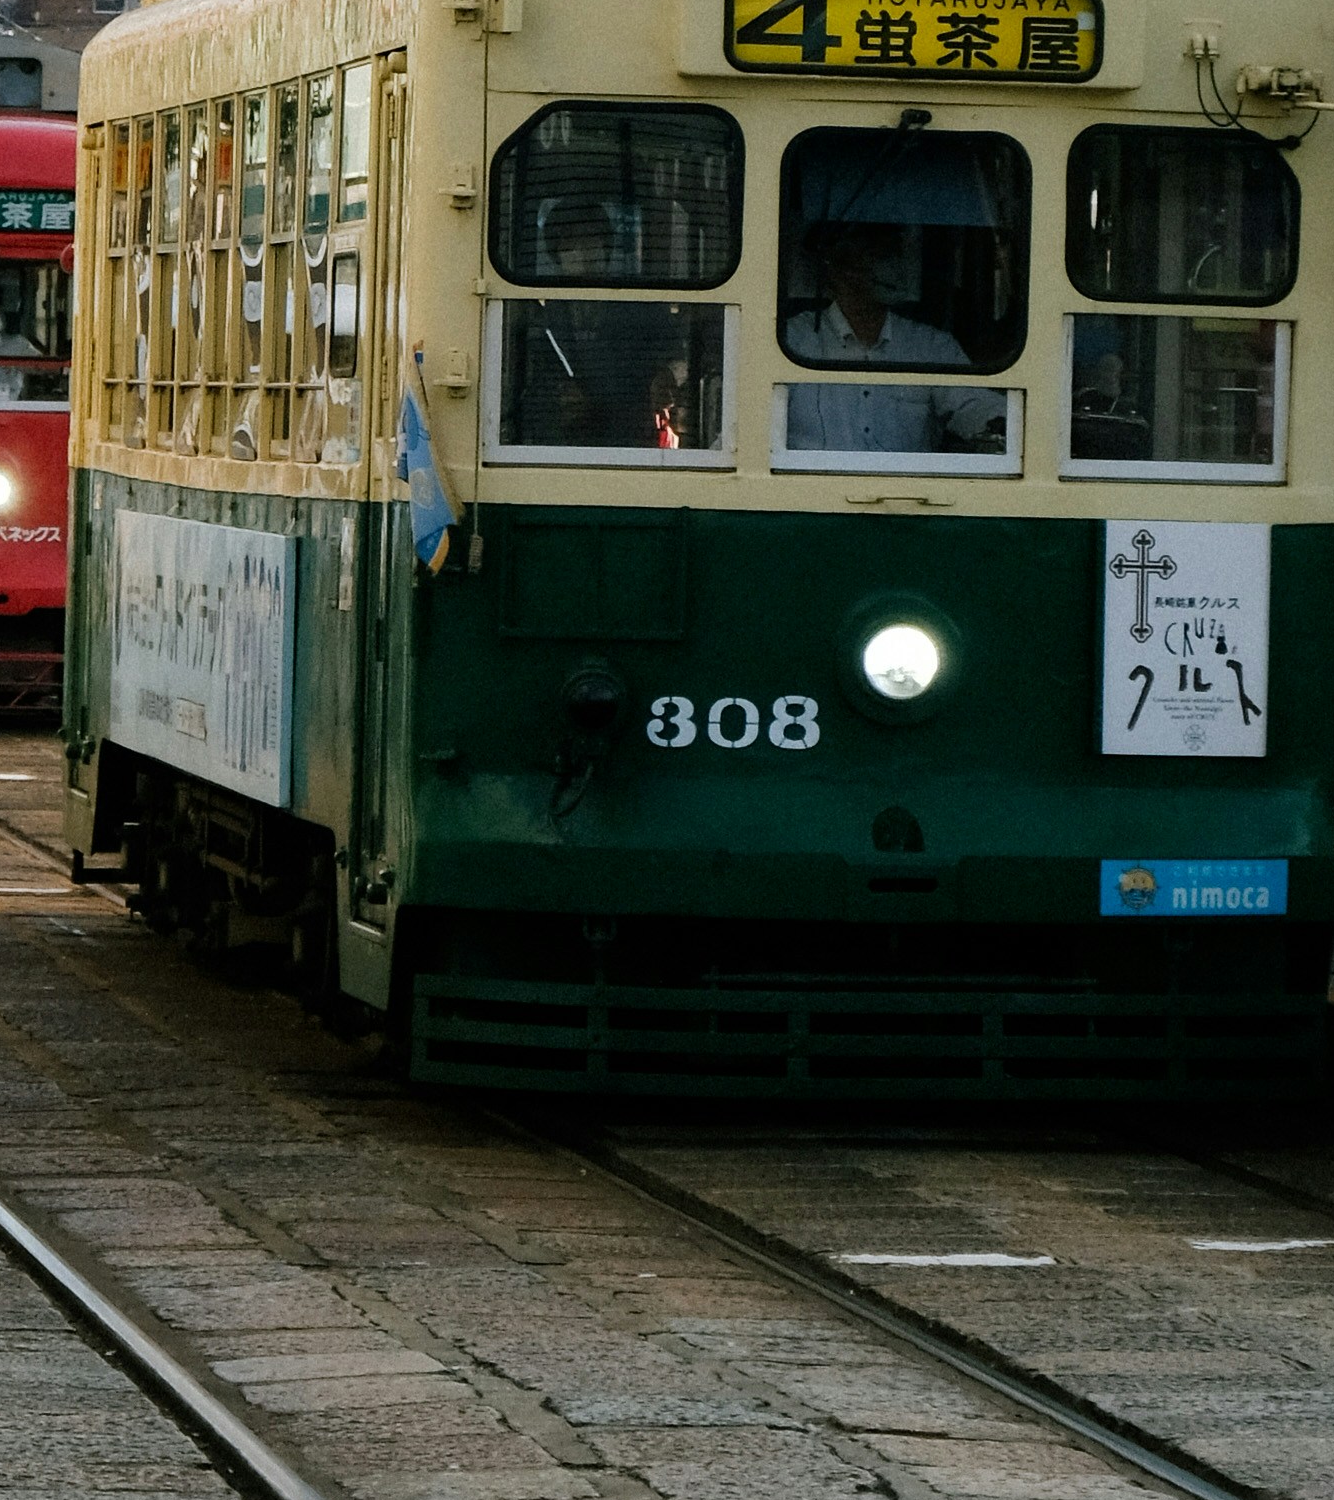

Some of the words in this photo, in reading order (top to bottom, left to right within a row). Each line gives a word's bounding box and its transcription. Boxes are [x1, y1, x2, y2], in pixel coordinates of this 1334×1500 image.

[854, 9, 1082, 71] 蛍茶屋
[646, 696, 821, 750] 308
[1173, 880, 1270, 909] nimoca
